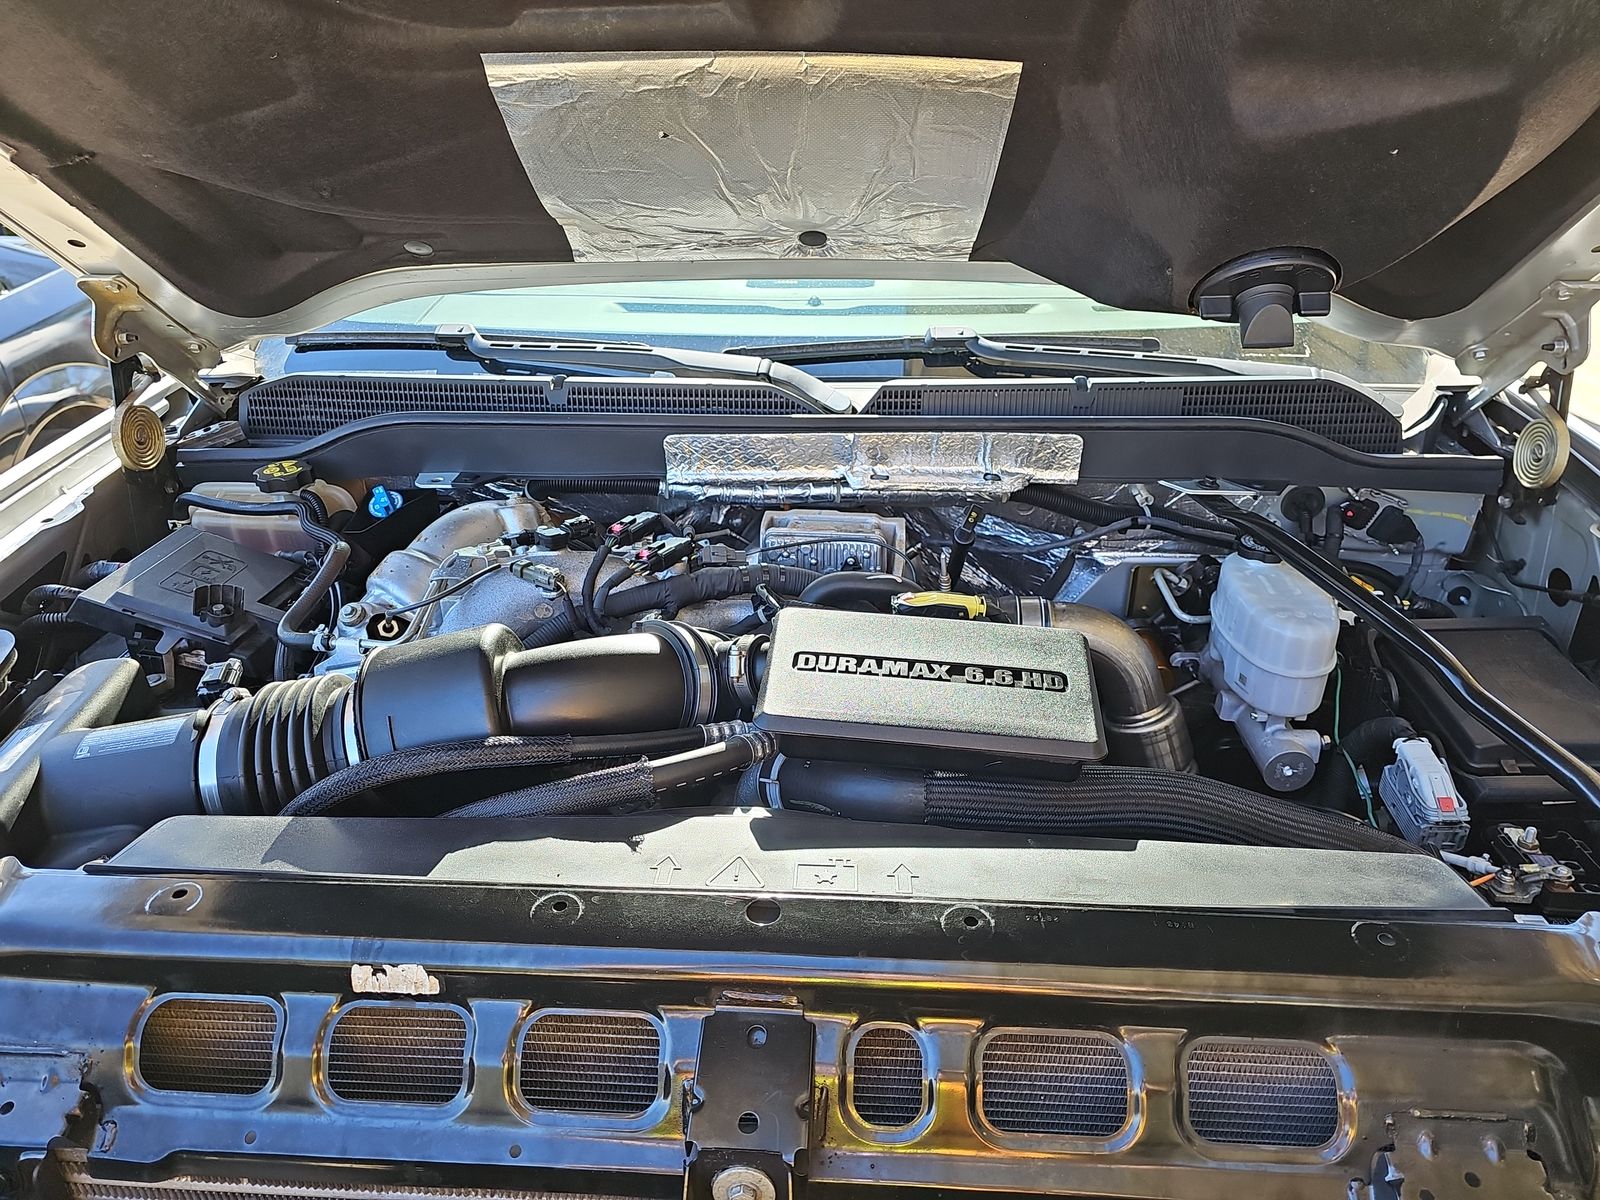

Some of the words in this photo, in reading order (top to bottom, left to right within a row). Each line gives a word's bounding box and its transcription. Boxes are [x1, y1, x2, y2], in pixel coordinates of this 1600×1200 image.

[797, 653, 952, 681] DURAMAX
[964, 666, 1014, 686] 6.6
[1022, 671, 1065, 691] HD
